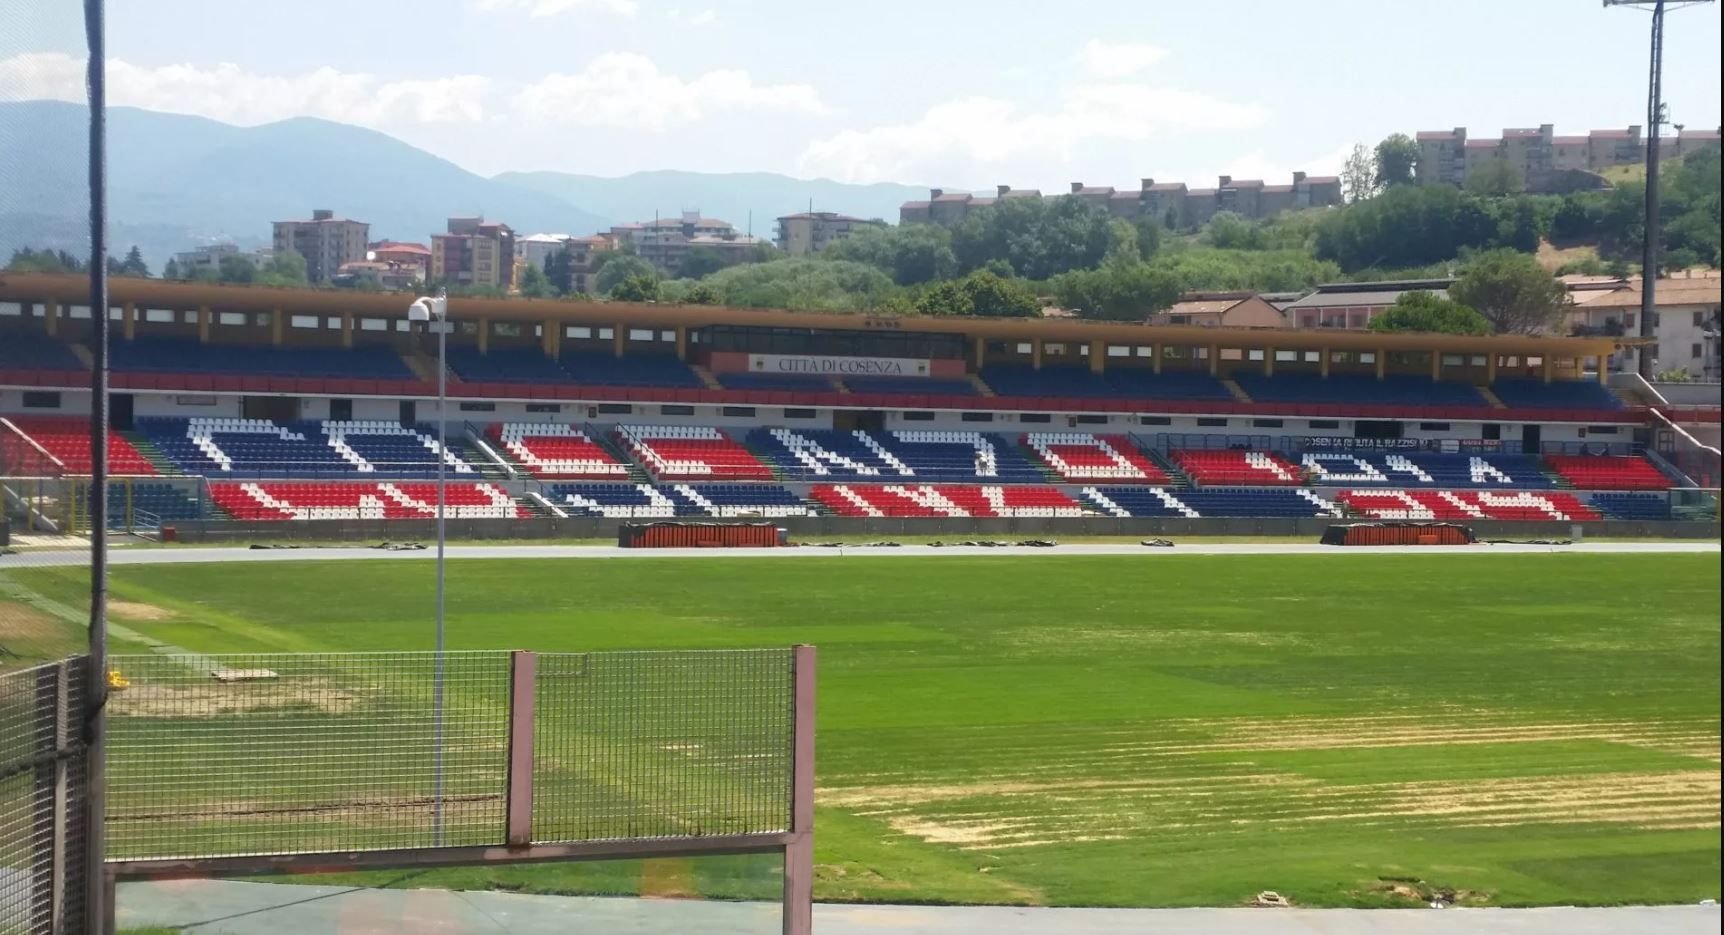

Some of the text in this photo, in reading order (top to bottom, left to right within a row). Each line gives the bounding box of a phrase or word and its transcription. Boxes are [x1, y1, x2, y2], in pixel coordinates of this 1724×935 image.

[779, 357, 902, 374] CITTÀ DI COSENZA
